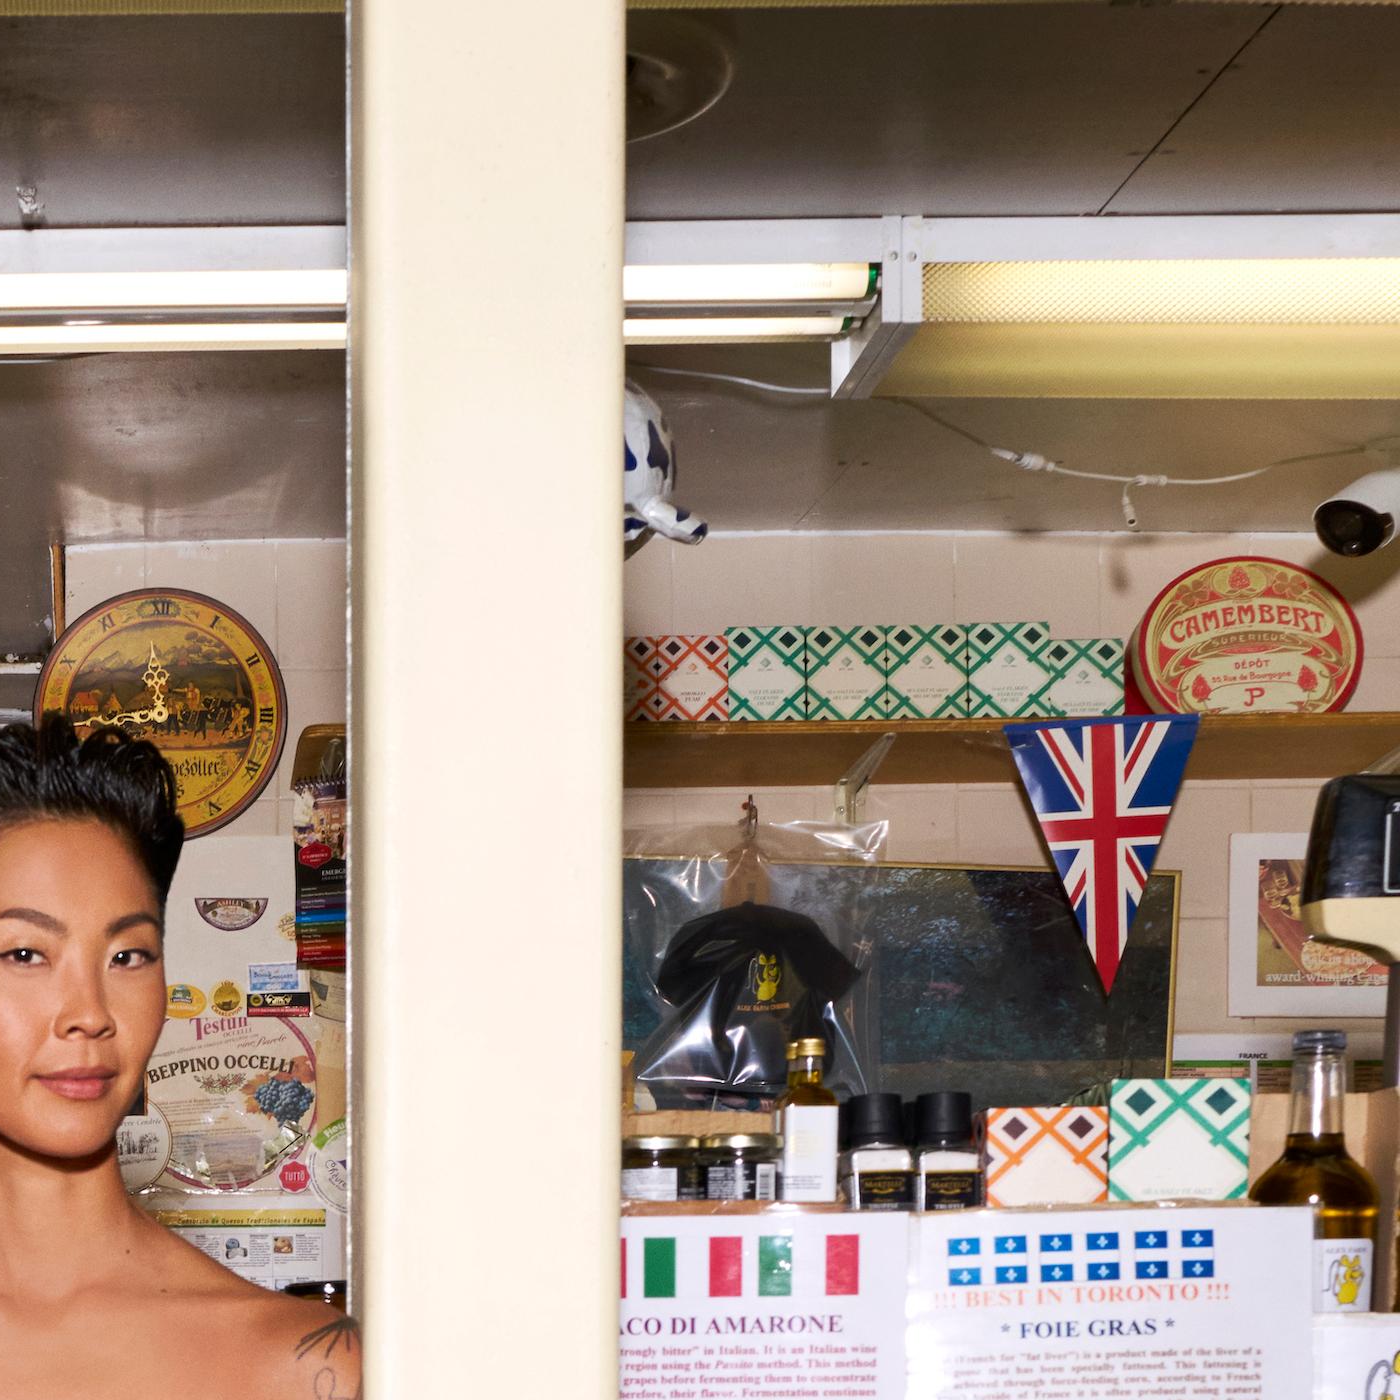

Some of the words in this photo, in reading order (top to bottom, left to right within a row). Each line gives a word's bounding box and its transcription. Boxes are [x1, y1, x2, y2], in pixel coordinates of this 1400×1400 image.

[1169, 604, 1325, 643] CAMEMBERT
[1234, 659, 1270, 670] DÉPÔT
[189, 1016, 248, 1041] Testun
[147, 1056, 219, 1085] BEPPINO
[224, 1055, 295, 1074] OCCELLI
[285, 1171, 305, 1182] TUTTO
[965, 1288, 1027, 1309] BEST
[1037, 1286, 1062, 1307] IN
[1072, 1283, 1200, 1305] TORONTO
[620, 1316, 662, 1336] CO
[670, 1316, 696, 1335] DI
[705, 1314, 844, 1335] AMARONE
[1020, 1320, 1081, 1339] FOIE
[1088, 1318, 1158, 1337] GRAS
[620, 1347, 656, 1358] trongly
[809, 1344, 846, 1354] Italian
[622, 1377, 657, 1386] grapes
[660, 1374, 695, 1384] before
[698, 1374, 760, 1385] fermenting
[764, 1373, 792, 1383] them
